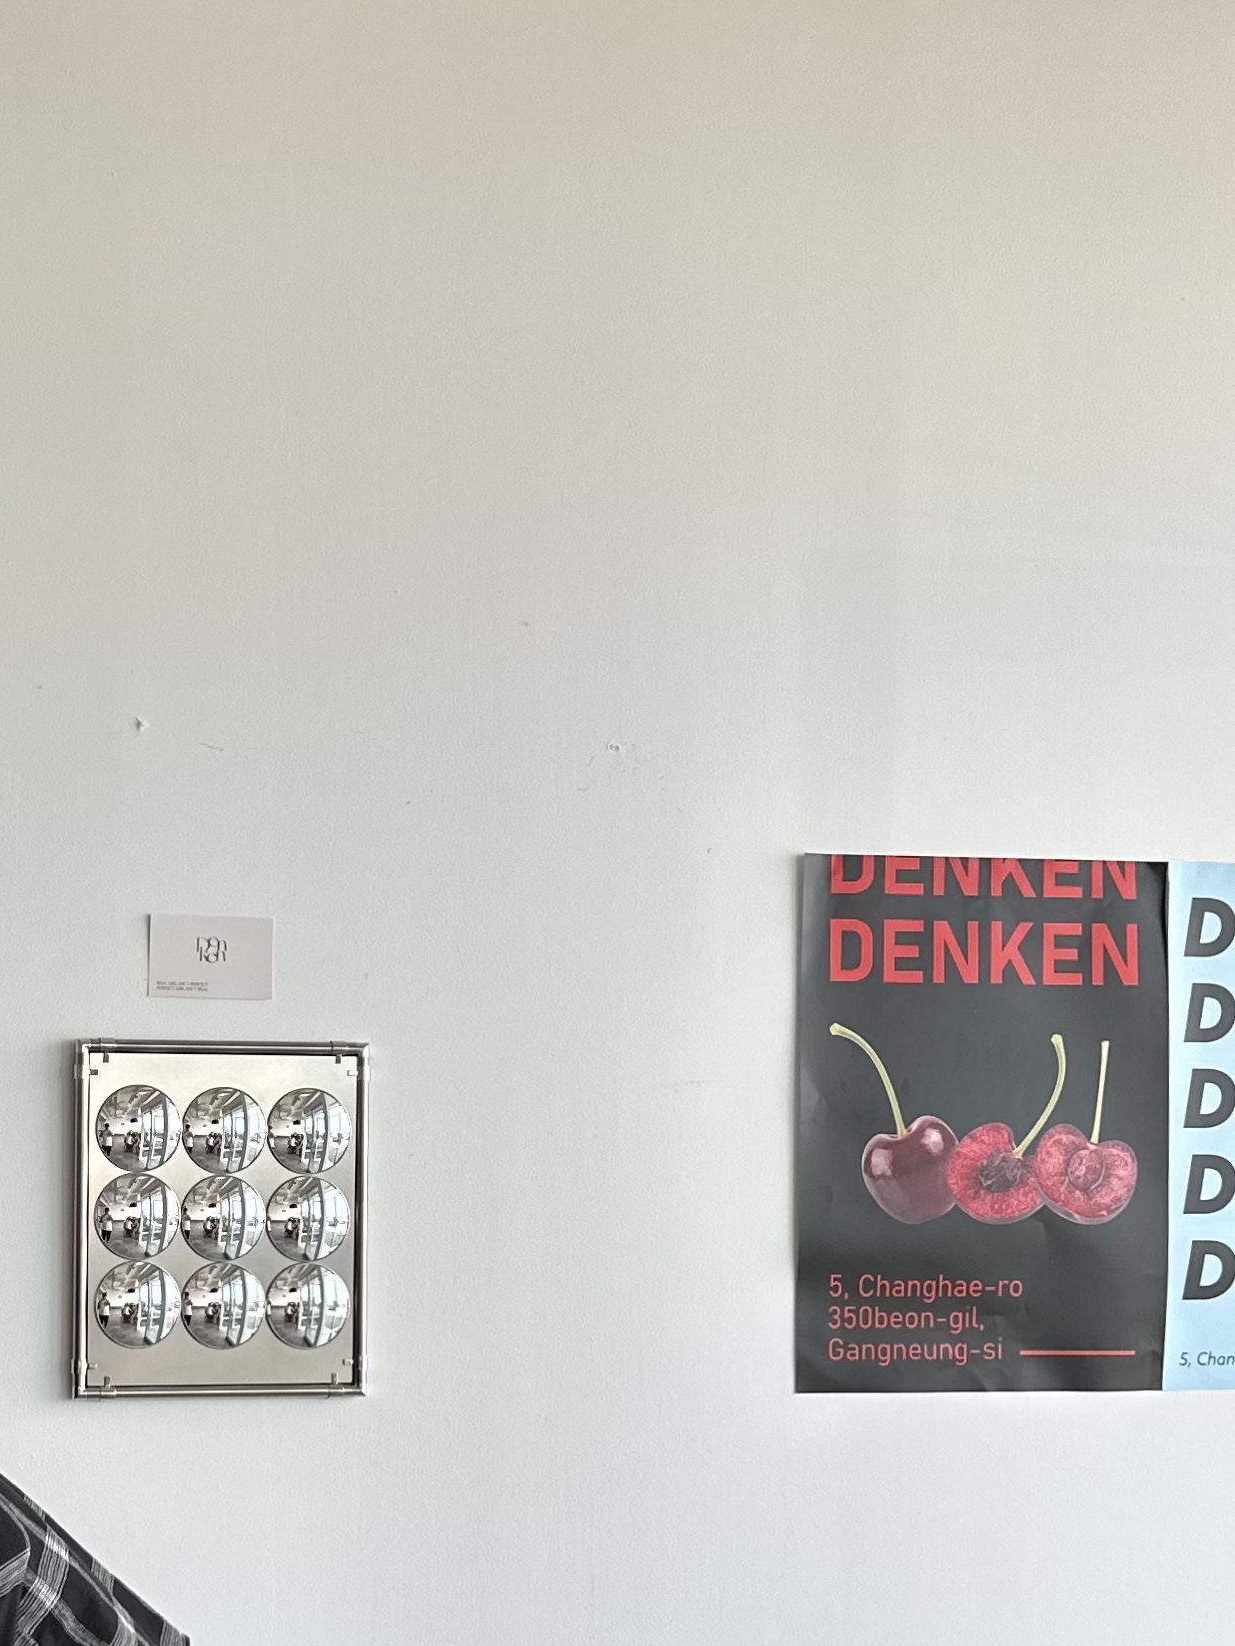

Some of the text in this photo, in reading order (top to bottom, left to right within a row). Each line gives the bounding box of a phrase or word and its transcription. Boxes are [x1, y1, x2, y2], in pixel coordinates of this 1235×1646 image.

[830, 855, 1137, 900] DENKEN
[829, 918, 1139, 986] DENKEN
[829, 1273, 1024, 1304] 5, Changhae-ro
[827, 1305, 985, 1335] 350beon-gil,
[827, 1336, 1004, 1367] Gangneung-si
[1178, 1351, 1192, 1369] 5,
